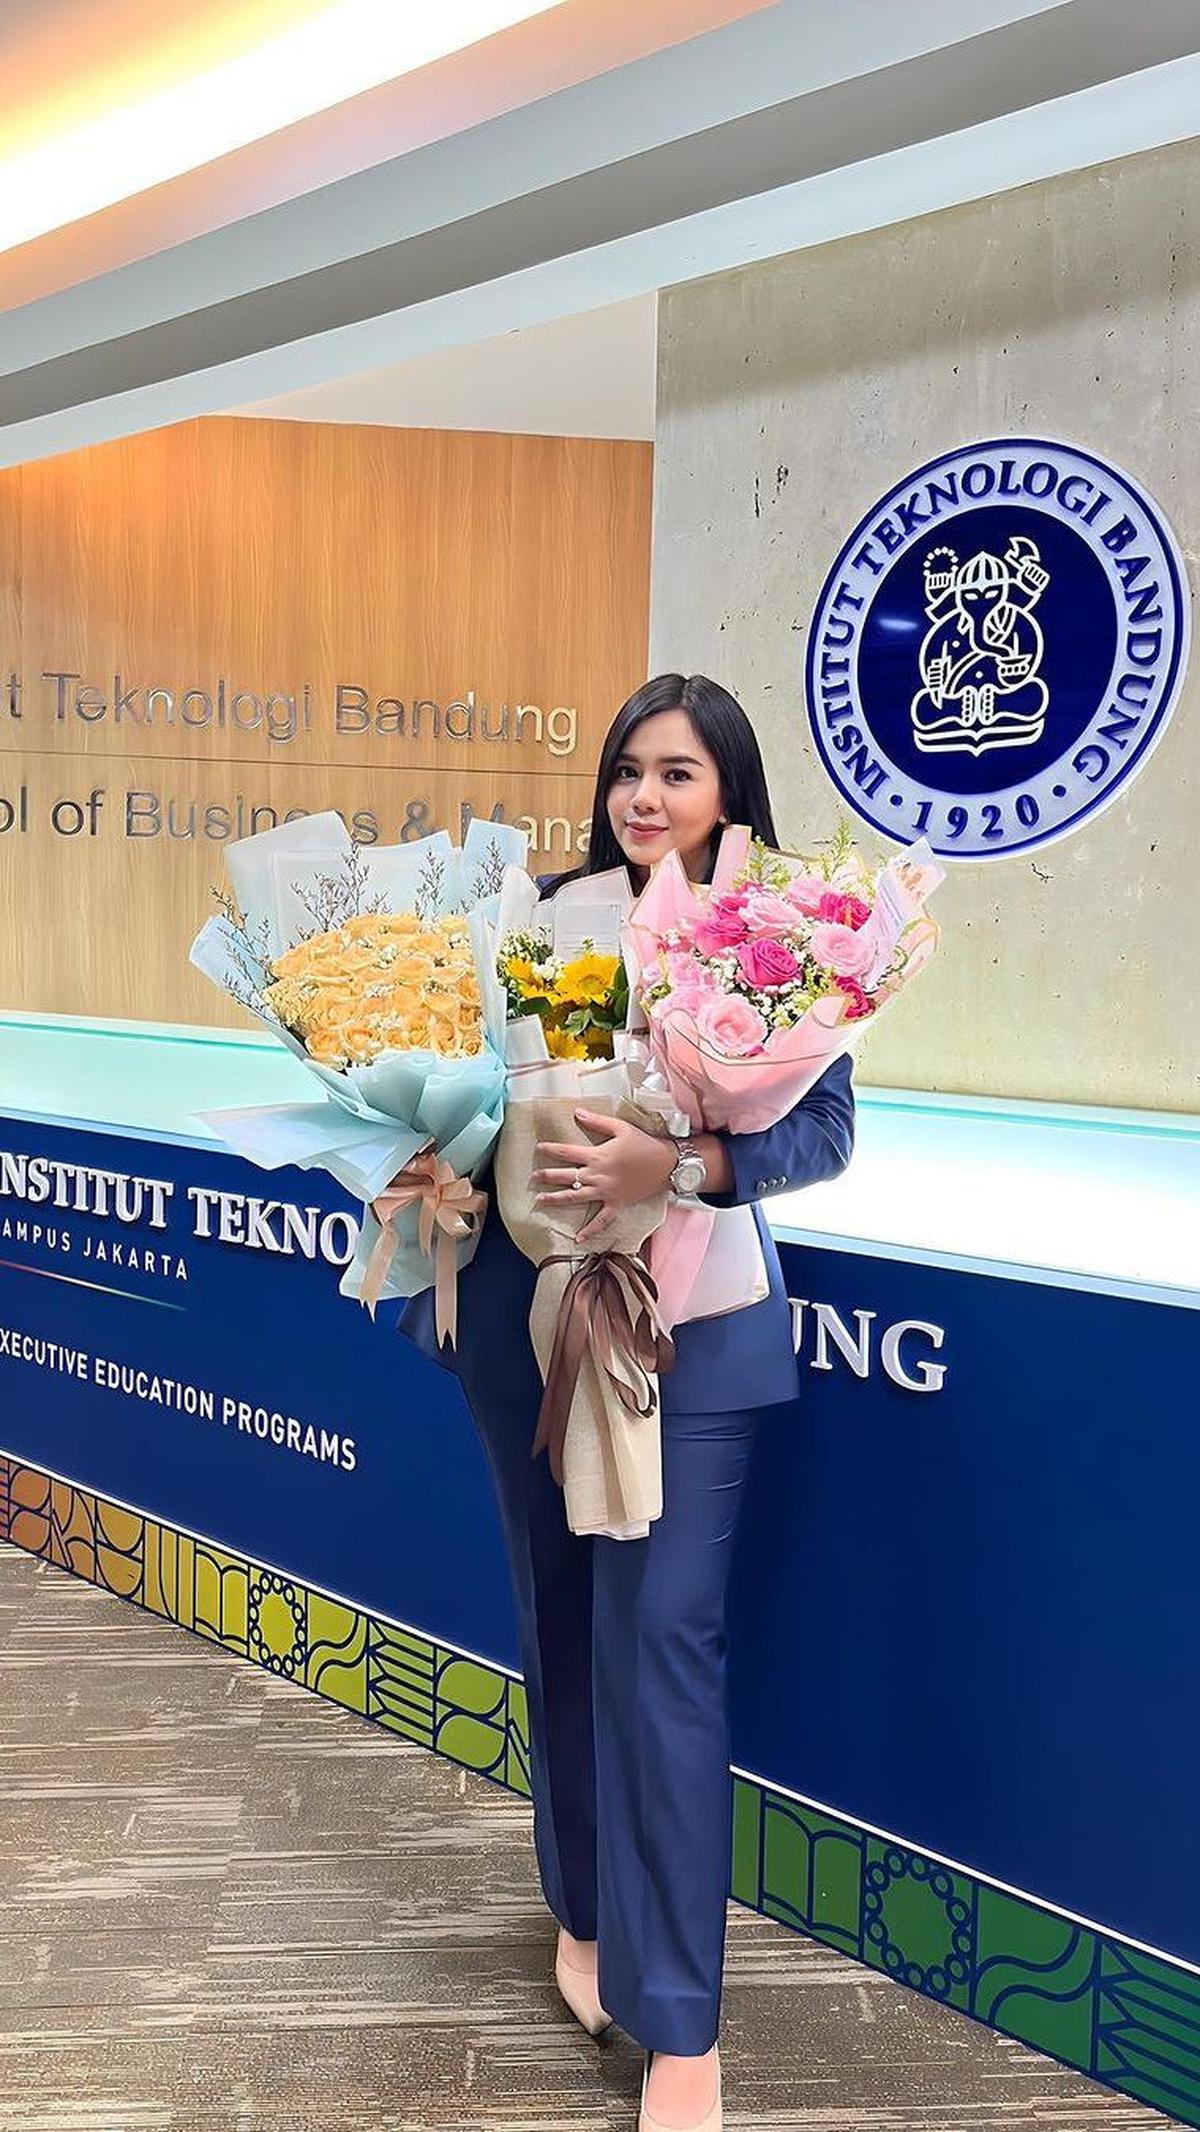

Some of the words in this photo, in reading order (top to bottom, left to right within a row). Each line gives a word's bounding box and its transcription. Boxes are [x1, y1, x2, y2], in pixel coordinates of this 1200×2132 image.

[852, 459, 1113, 578] TEKNOLOGI
[821, 582, 890, 800] INSTITUT
[1072, 513, 1163, 783] BANDUNG
[42, 672, 311, 743] Teknologi
[335, 685, 577, 755] Bandung
[52, 788, 105, 836] of
[126, 790, 379, 845] Busins
[912, 794, 1040, 839] 1920
[0, 1152, 174, 1229] NSTITUT
[188, 1187, 359, 1265] TEKNO
[3, 1218, 71, 1251] AMPUS
[84, 1237, 188, 1280] JAKARTA
[0, 1328, 88, 1380] XECUTIVE
[95, 1358, 214, 1420] EDUCATION
[223, 1397, 357, 1471] PROGRAMS
